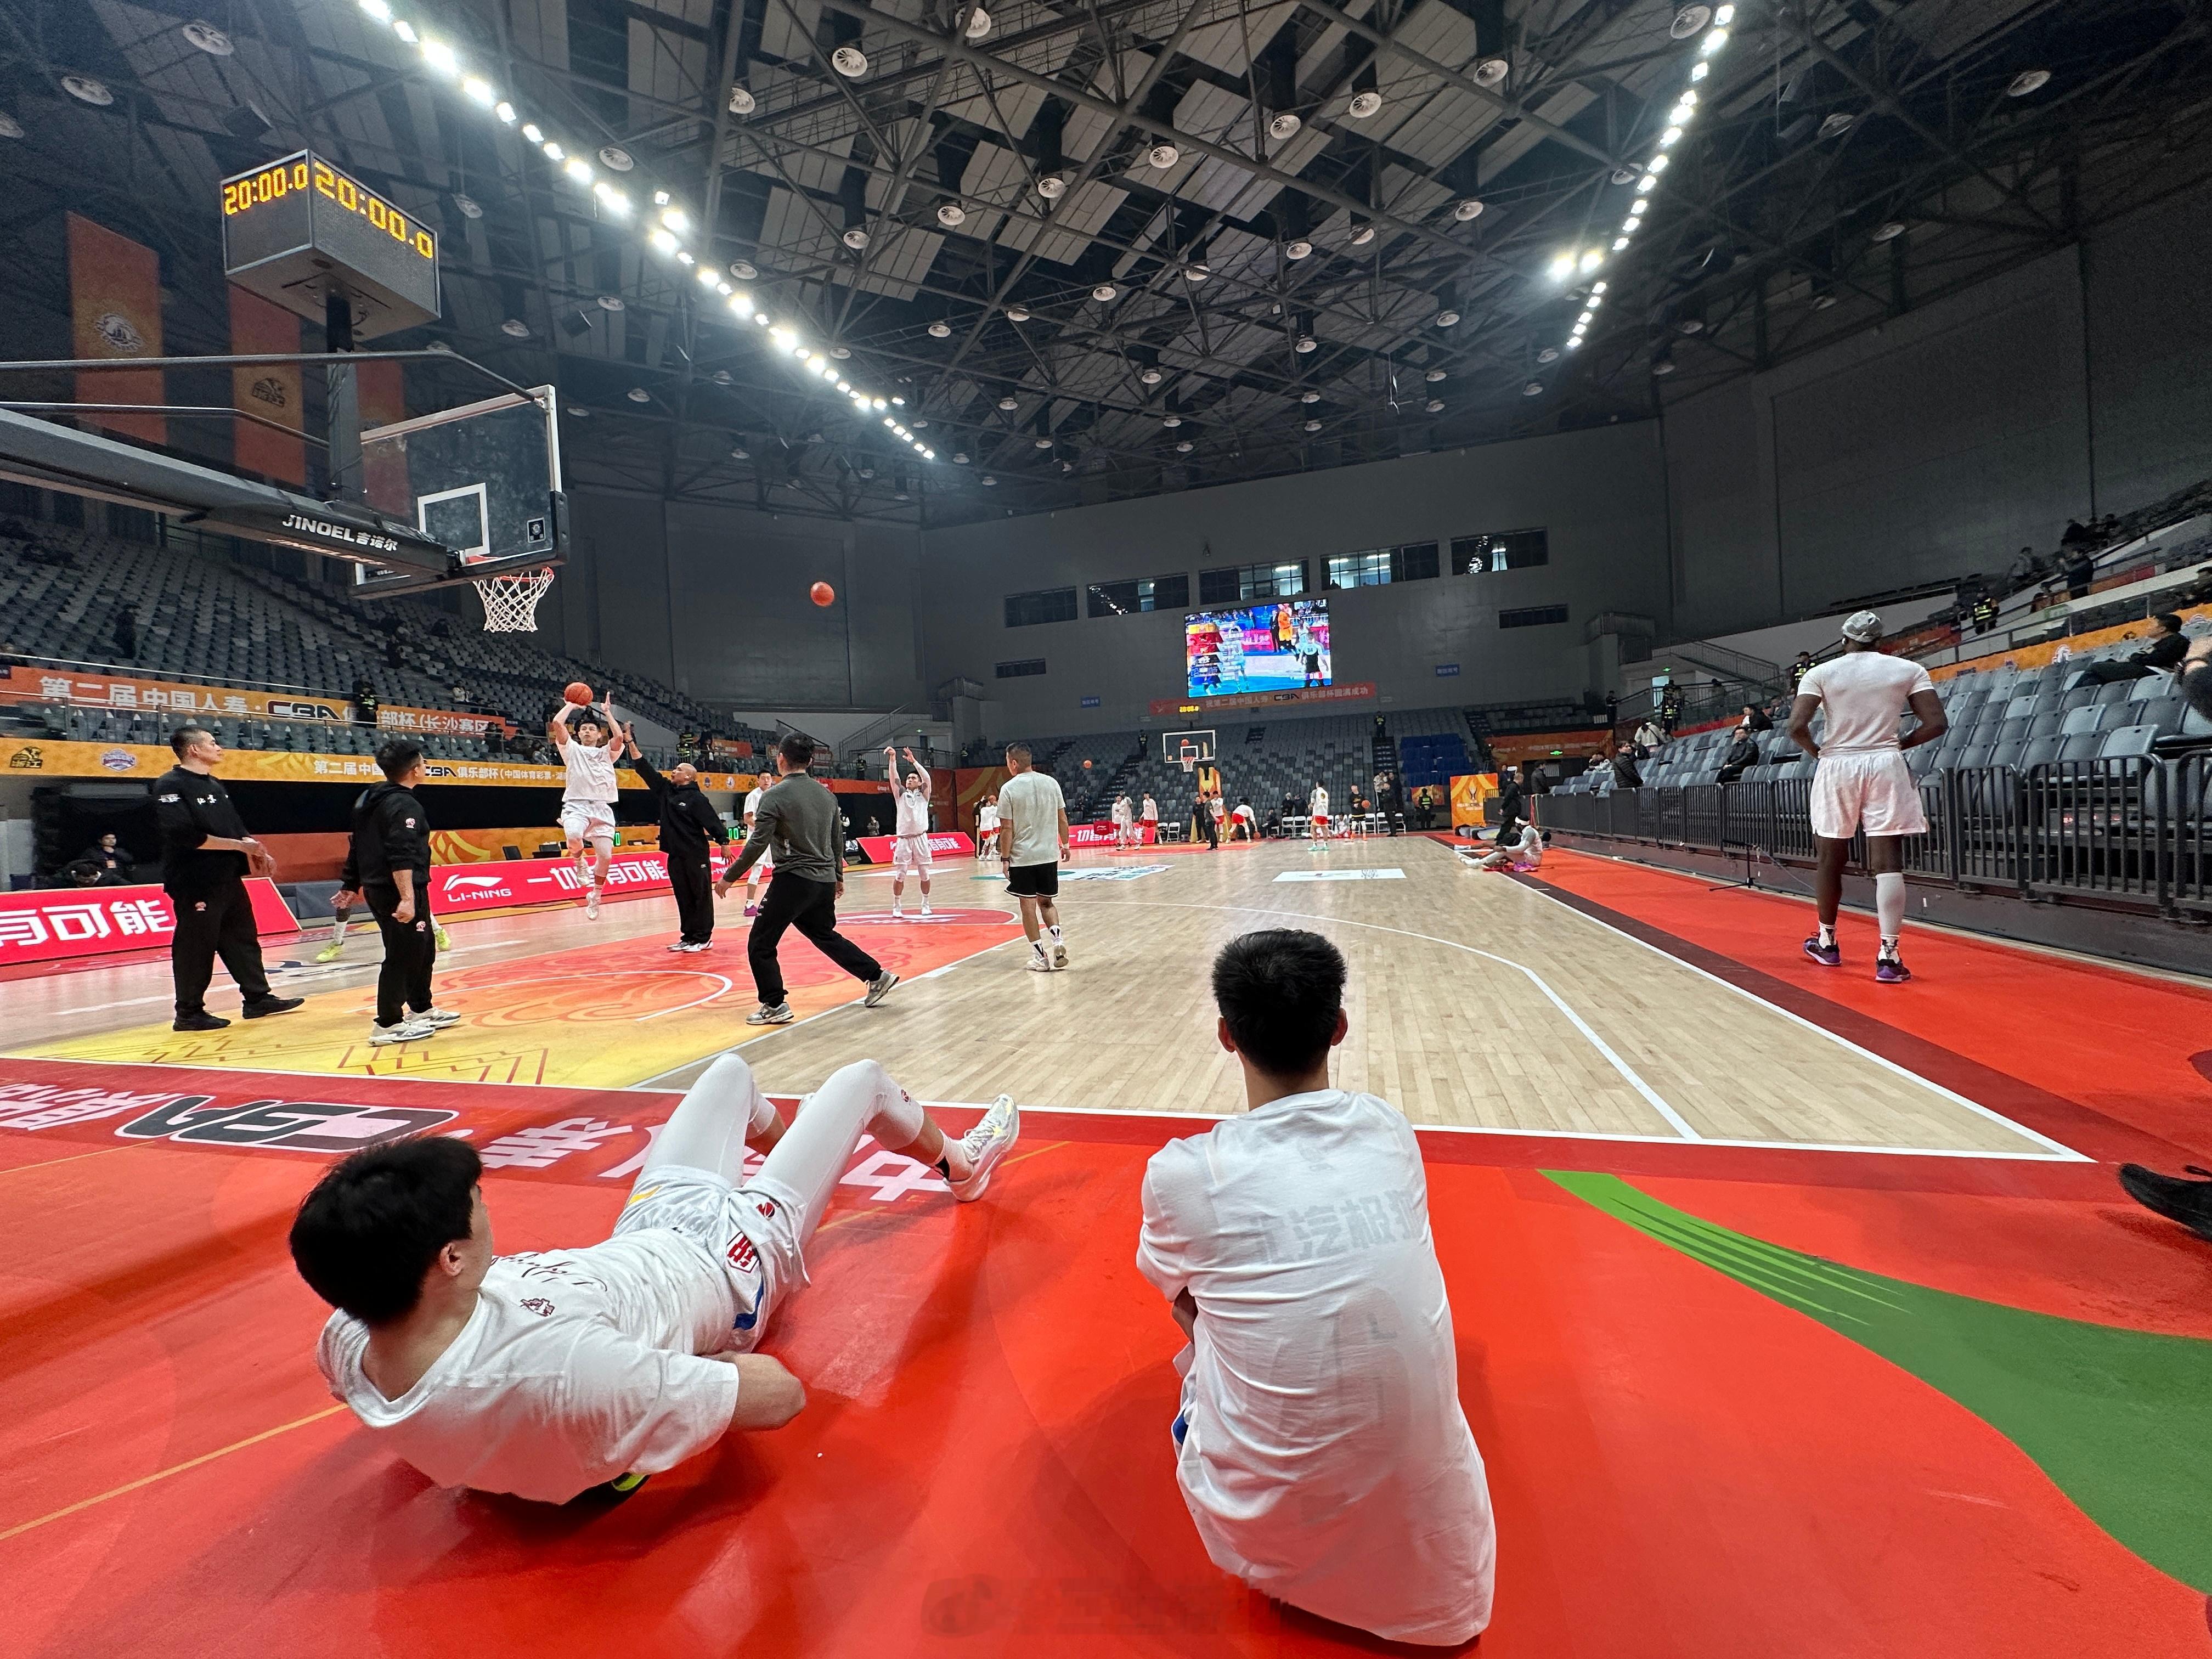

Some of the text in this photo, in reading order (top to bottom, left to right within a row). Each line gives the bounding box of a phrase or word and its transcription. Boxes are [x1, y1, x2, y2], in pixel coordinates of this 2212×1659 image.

[224, 162, 308, 215] 20:00.0
[314, 161, 433, 259] 20:00.0
[282, 514, 399, 552] JINOEL 吉诺尔
[314, 760, 386, 776] 第二届中国
[447, 888, 512, 902] LI-NING
